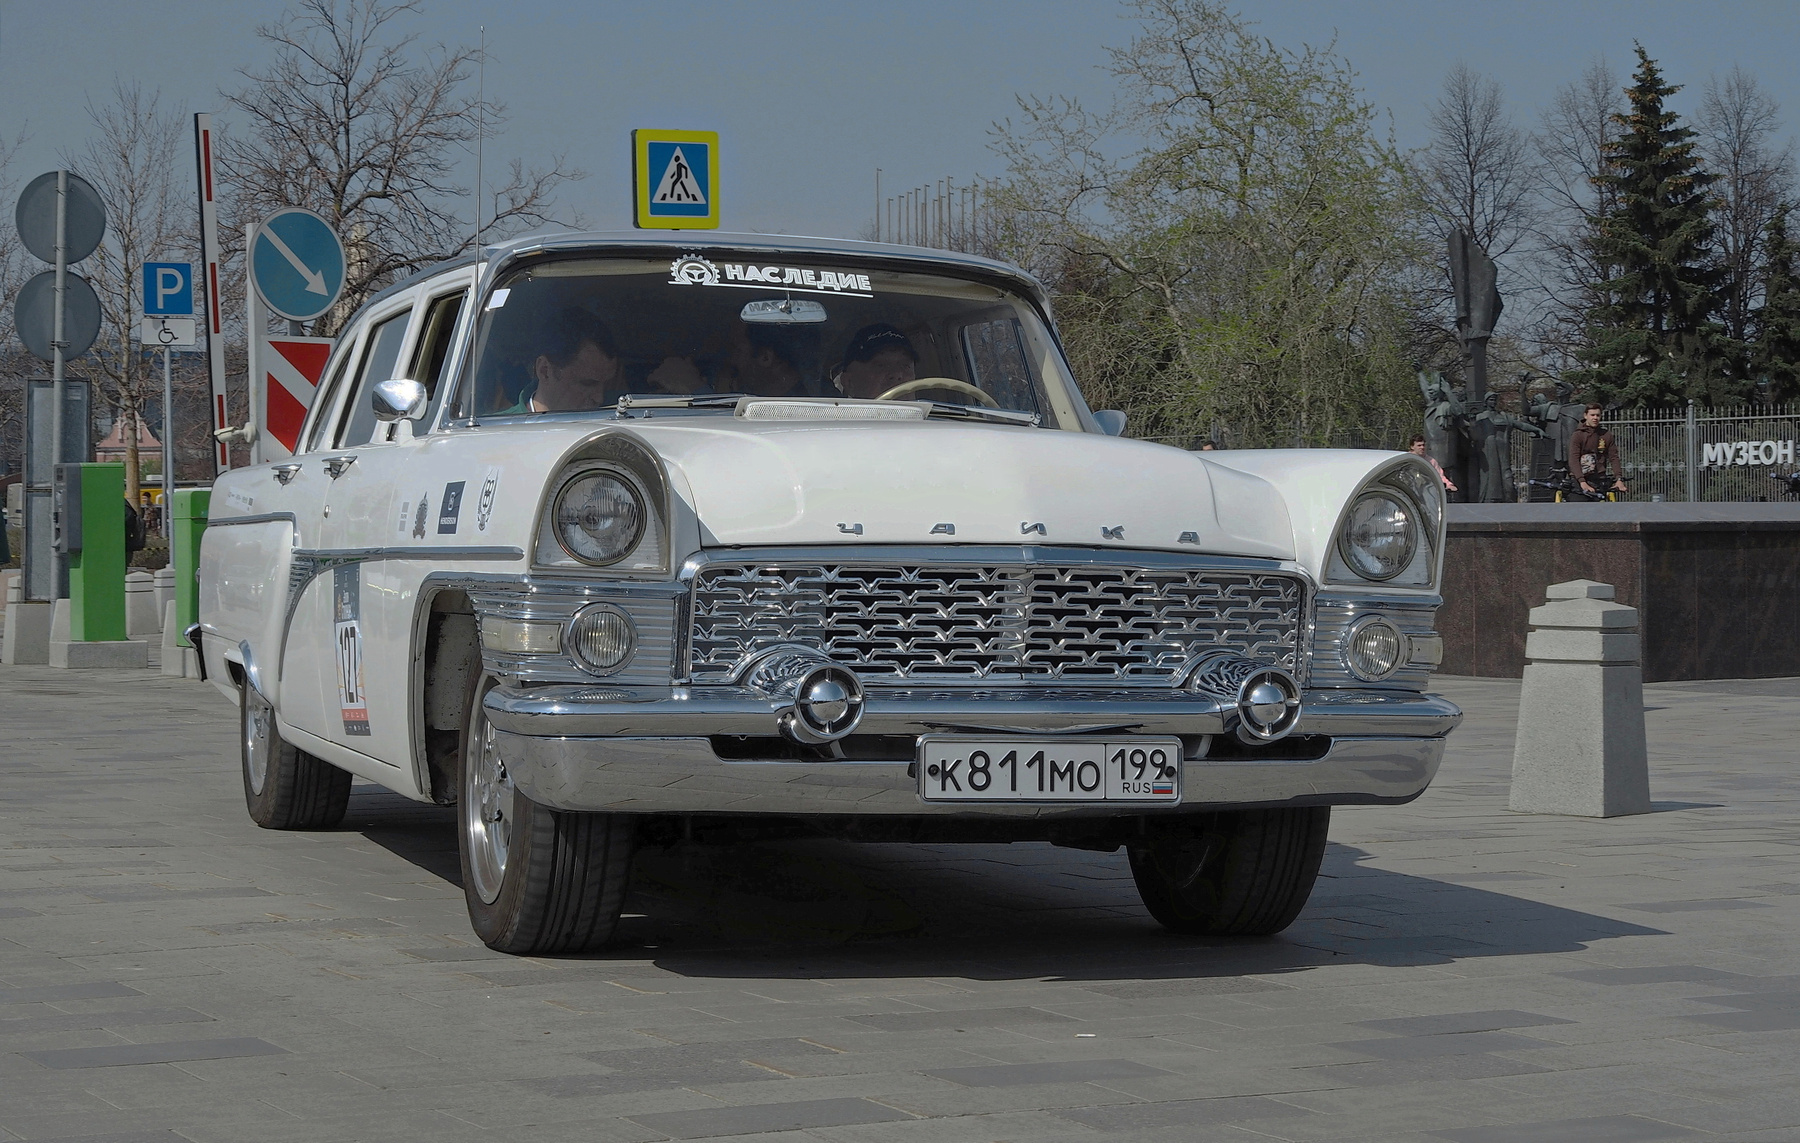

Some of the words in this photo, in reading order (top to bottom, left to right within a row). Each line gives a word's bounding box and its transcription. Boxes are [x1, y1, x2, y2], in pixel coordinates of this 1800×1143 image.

[156, 267, 184, 310] P
[724, 264, 872, 291] НАСЛЕДИЕ
[1703, 440, 1794, 467] МУЗЕОН
[340, 626, 358, 703] 127
[1110, 748, 1167, 780] 199
[1122, 782, 1151, 794] RUS
